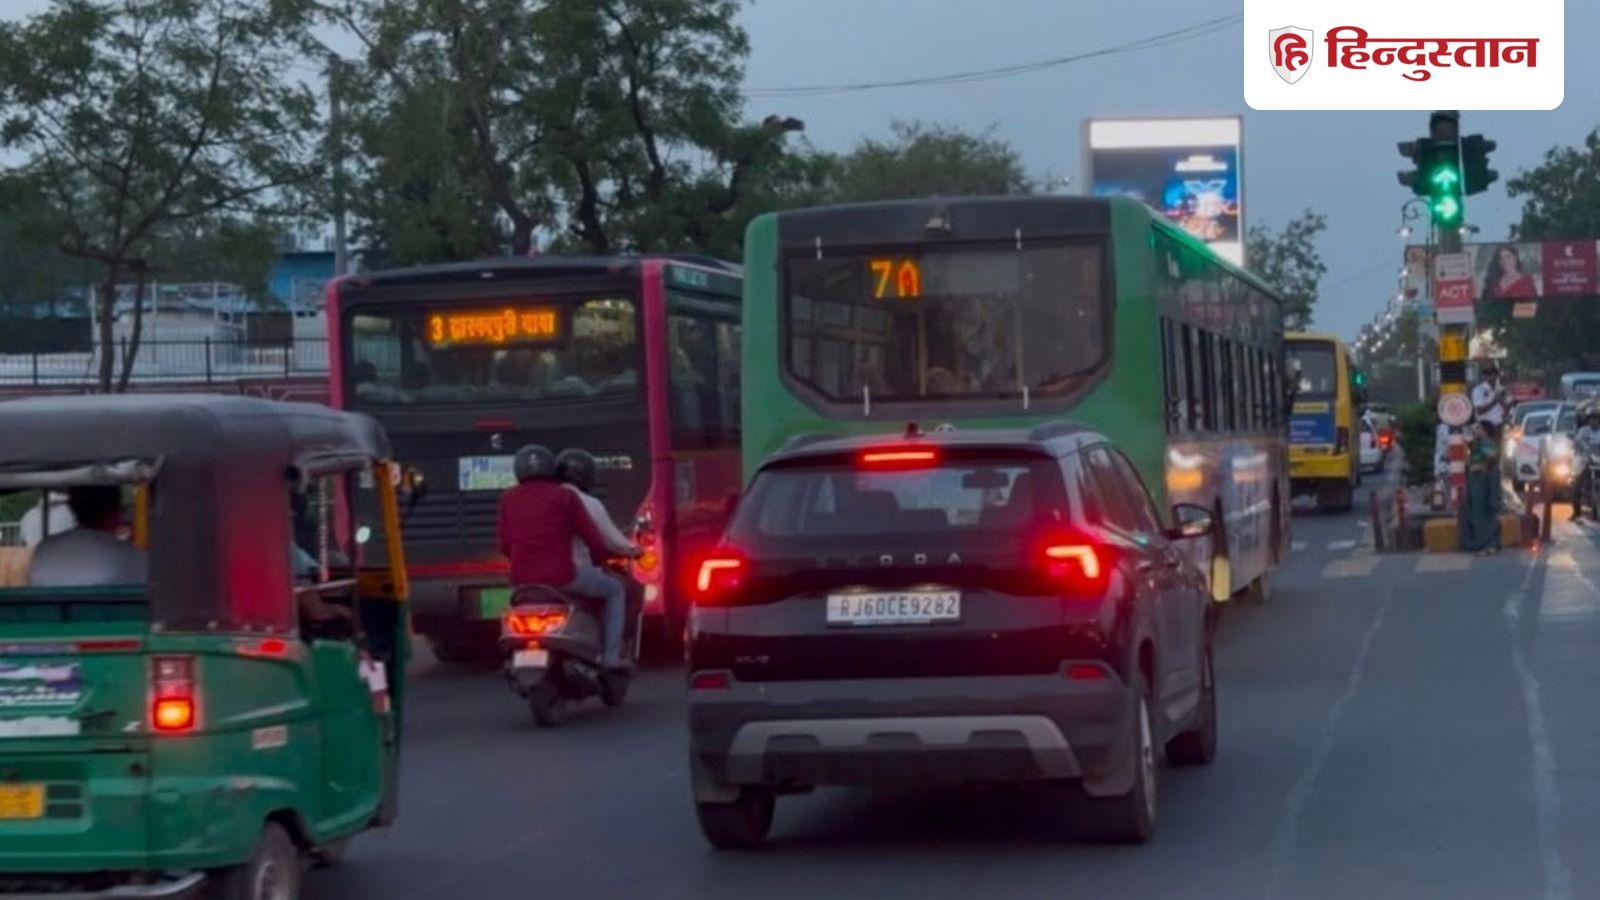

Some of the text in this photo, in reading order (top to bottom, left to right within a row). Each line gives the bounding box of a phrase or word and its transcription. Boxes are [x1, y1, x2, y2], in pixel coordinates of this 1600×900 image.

[871, 260, 919, 298] 7A
[431, 316, 443, 341] 3
[840, 595, 956, 617] RJ60CE9282
